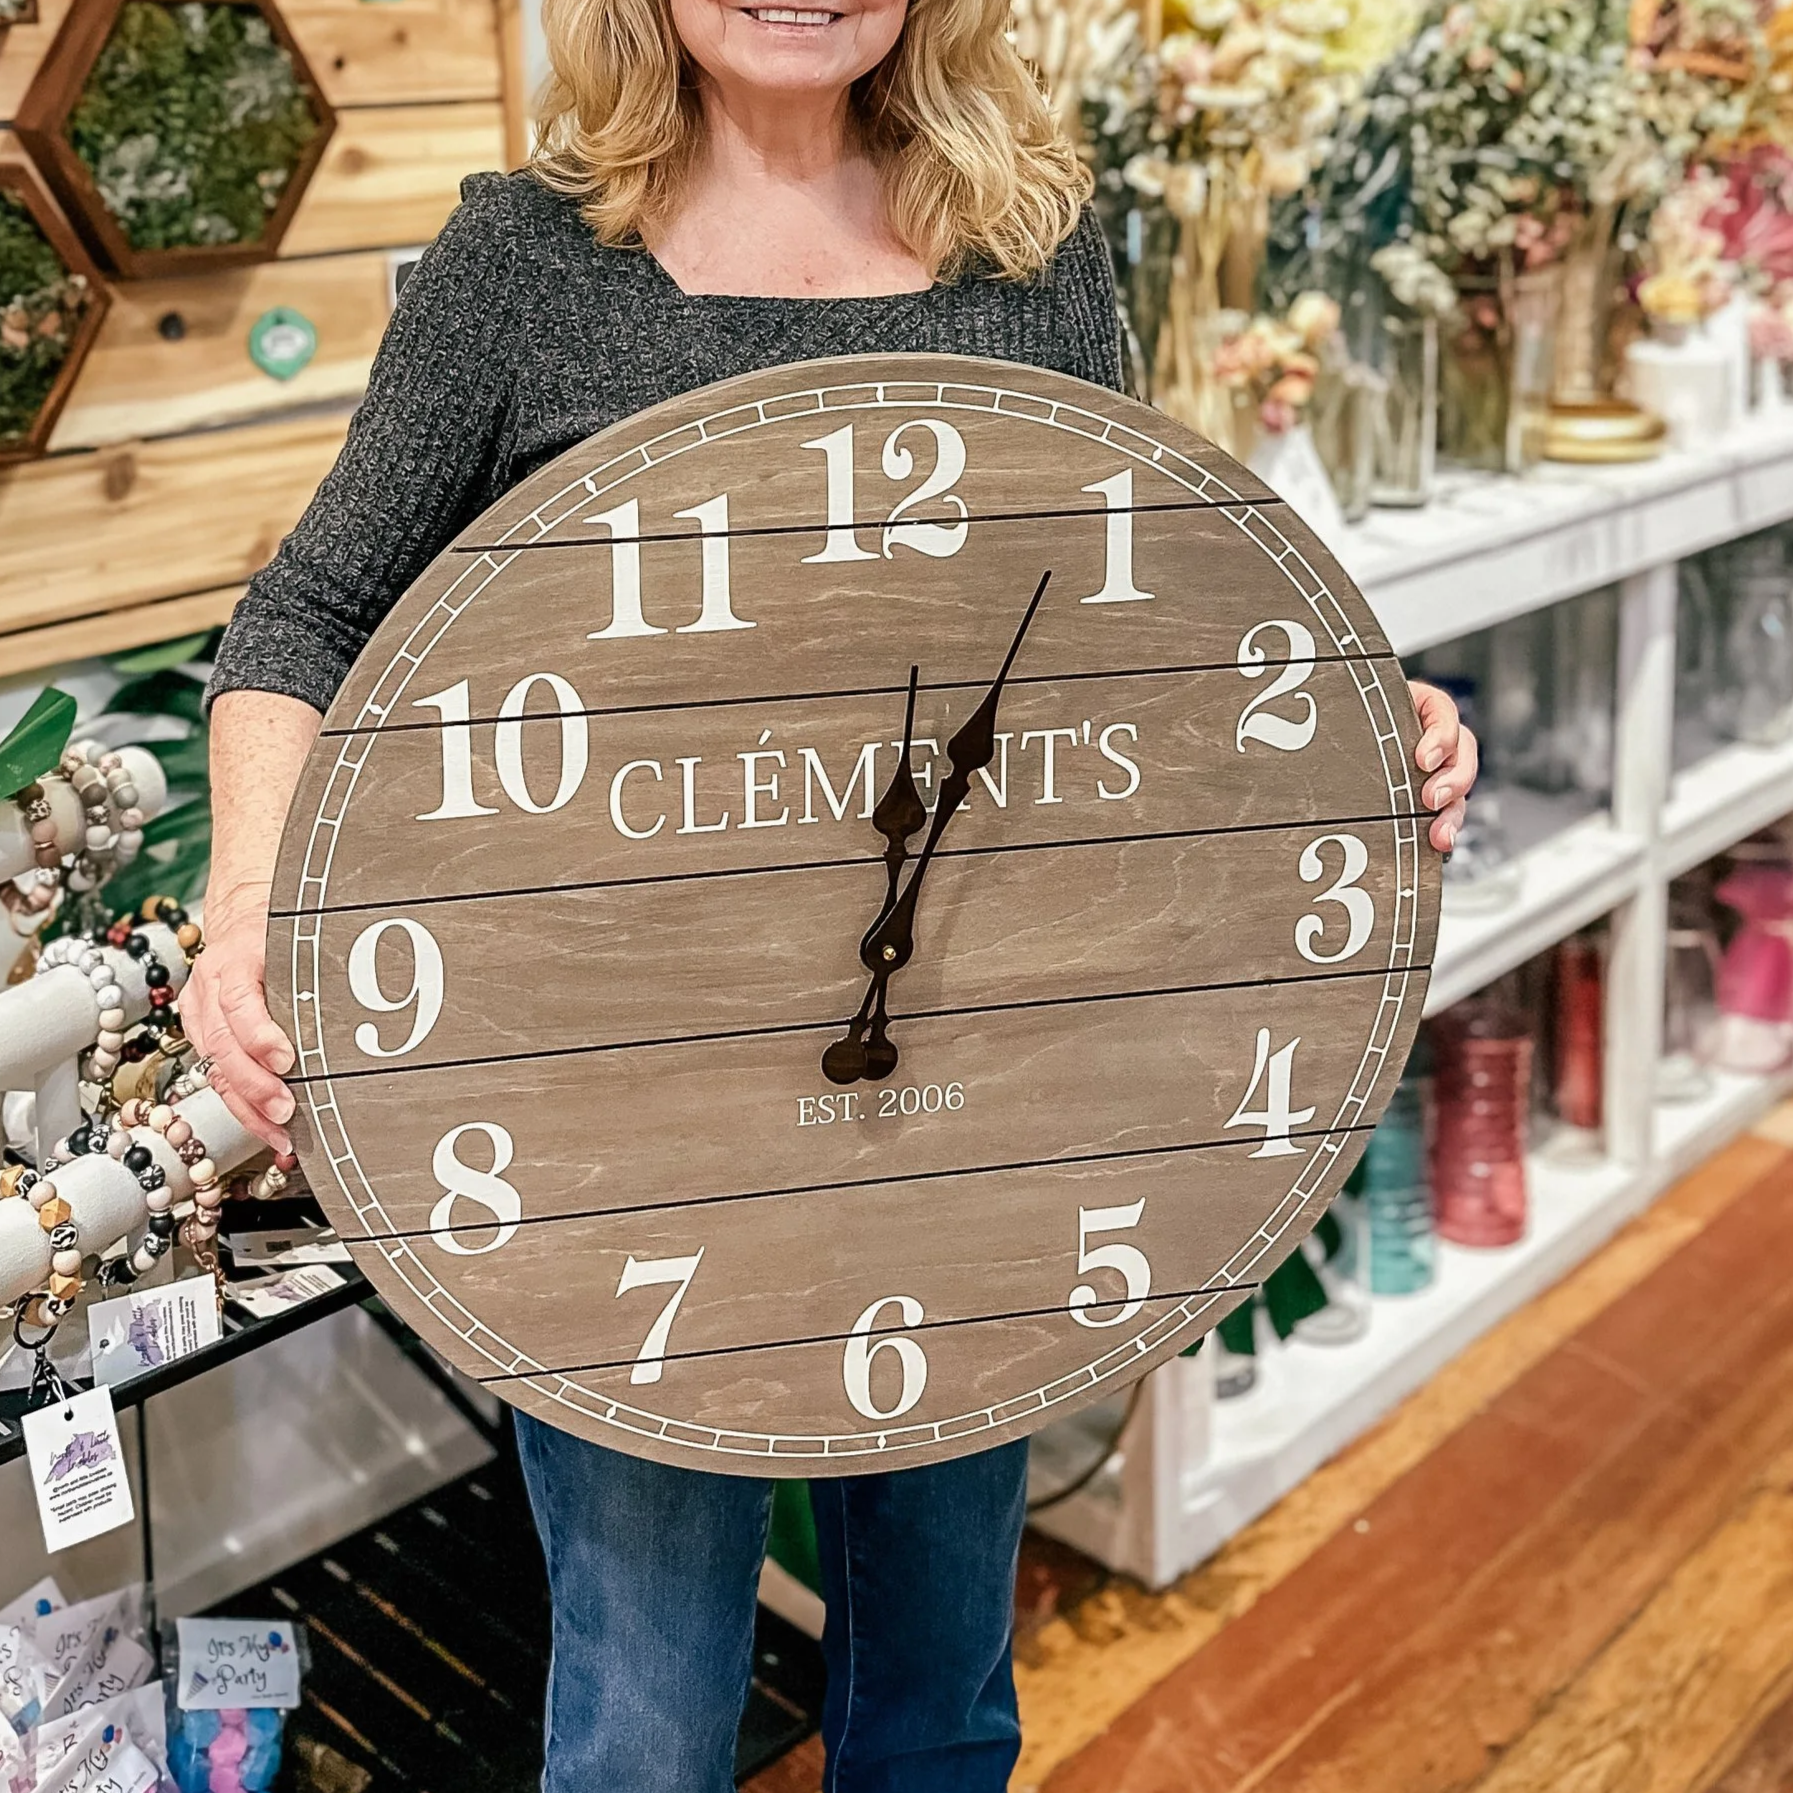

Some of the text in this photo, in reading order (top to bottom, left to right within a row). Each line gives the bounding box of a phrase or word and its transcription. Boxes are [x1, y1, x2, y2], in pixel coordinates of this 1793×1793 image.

[800, 420, 970, 563] 12
[1081, 468, 1156, 604] 1
[583, 493, 757, 640] 11
[411, 672, 588, 822] 10
[1236, 619, 1317, 753] 2
[1295, 833, 1375, 964] 3
[348, 917, 445, 1058] 9
[795, 1082, 966, 1128] EST. 2006
[1223, 1027, 1316, 1159] 4
[429, 1122, 523, 1257] 8
[615, 1246, 705, 1387] 7
[1068, 1197, 1151, 1330] 5
[843, 1295, 927, 1421] 6
[216, 1663, 268, 1696] Party
